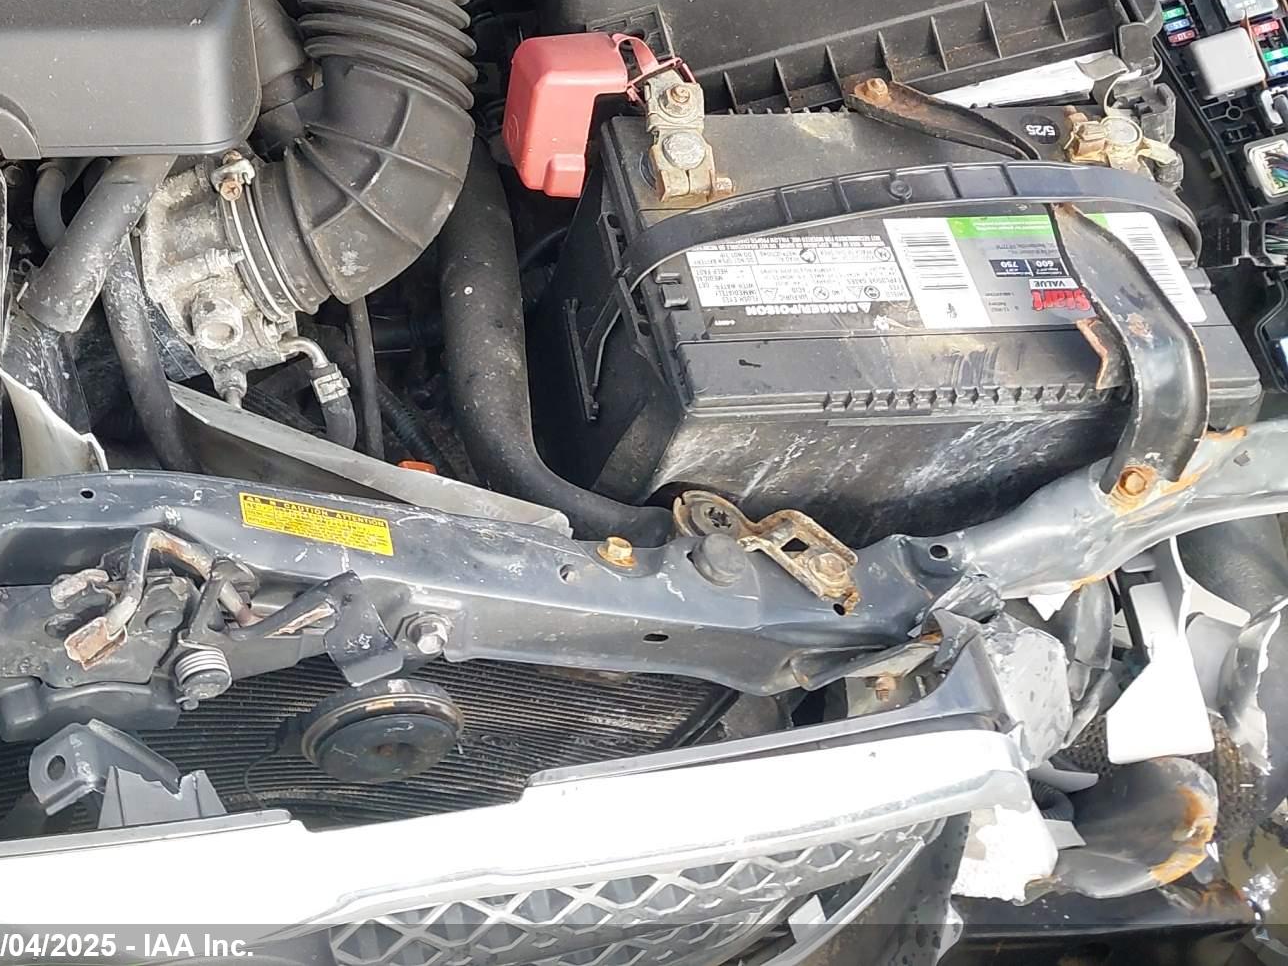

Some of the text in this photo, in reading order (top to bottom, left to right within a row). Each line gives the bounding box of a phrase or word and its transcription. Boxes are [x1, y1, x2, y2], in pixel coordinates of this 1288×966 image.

[1025, 124, 1056, 137] 5/25
[1033, 280, 1065, 288] VALUE
[283, 502, 328, 517] CAUTION
[335, 513, 387, 528] ATTENTION
